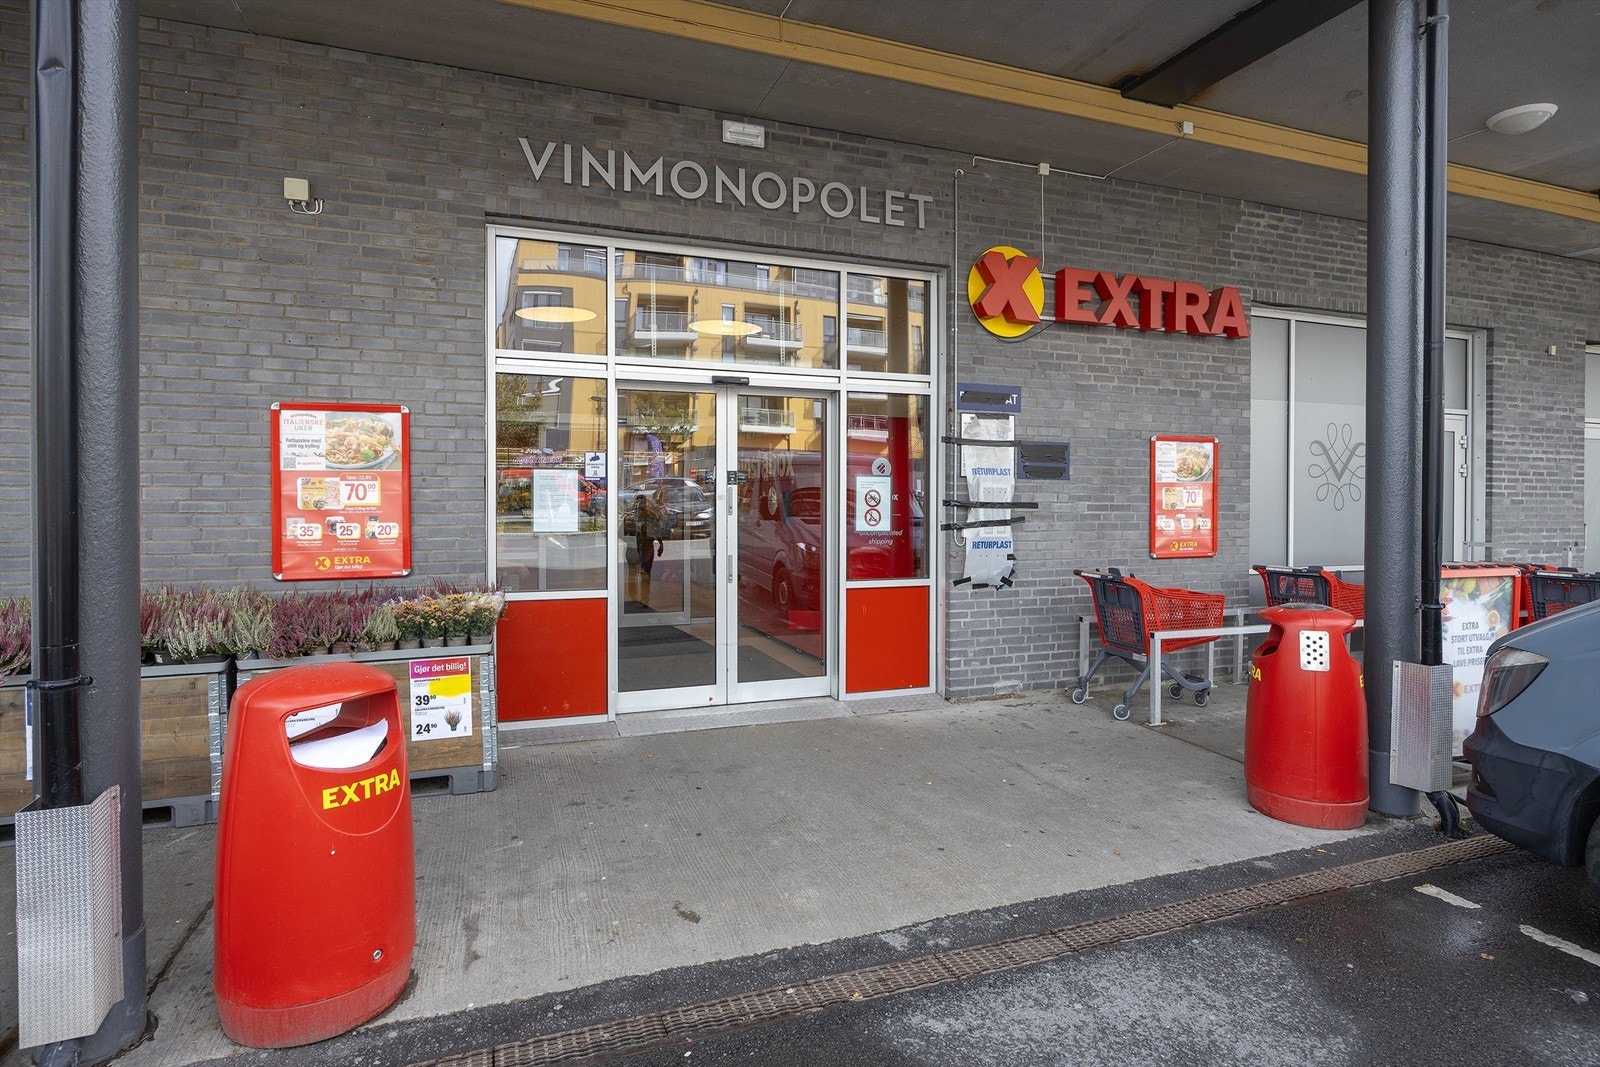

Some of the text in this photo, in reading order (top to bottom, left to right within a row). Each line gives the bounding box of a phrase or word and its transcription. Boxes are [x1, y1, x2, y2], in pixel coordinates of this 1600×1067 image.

[518, 137, 933, 229] VINMONOPOLET
[1055, 267, 1250, 339] EXTRA
[283, 418, 324, 426] ITALIENSKE
[971, 467, 1011, 477] RETURPLAST
[344, 483, 367, 501] 70
[1185, 490, 1197, 504] 70
[299, 525, 314, 537] 35
[339, 525, 353, 536] 25
[377, 524, 392, 536] 20
[868, 538, 893, 546] shipping
[972, 540, 1012, 549] RETURPLAST
[334, 556, 371, 565] EXTRA
[1462, 622, 1479, 630] EXTRA
[1451, 635, 1469, 644] STORT
[1457, 645, 1483, 655] TIL EXTRA
[414, 662, 467, 675] Gjør det billig!
[1453, 659, 1467, 668] LAVE
[415, 695, 430, 706] 39
[416, 723, 431, 735] 24
[322, 768, 401, 810] EXTRA
